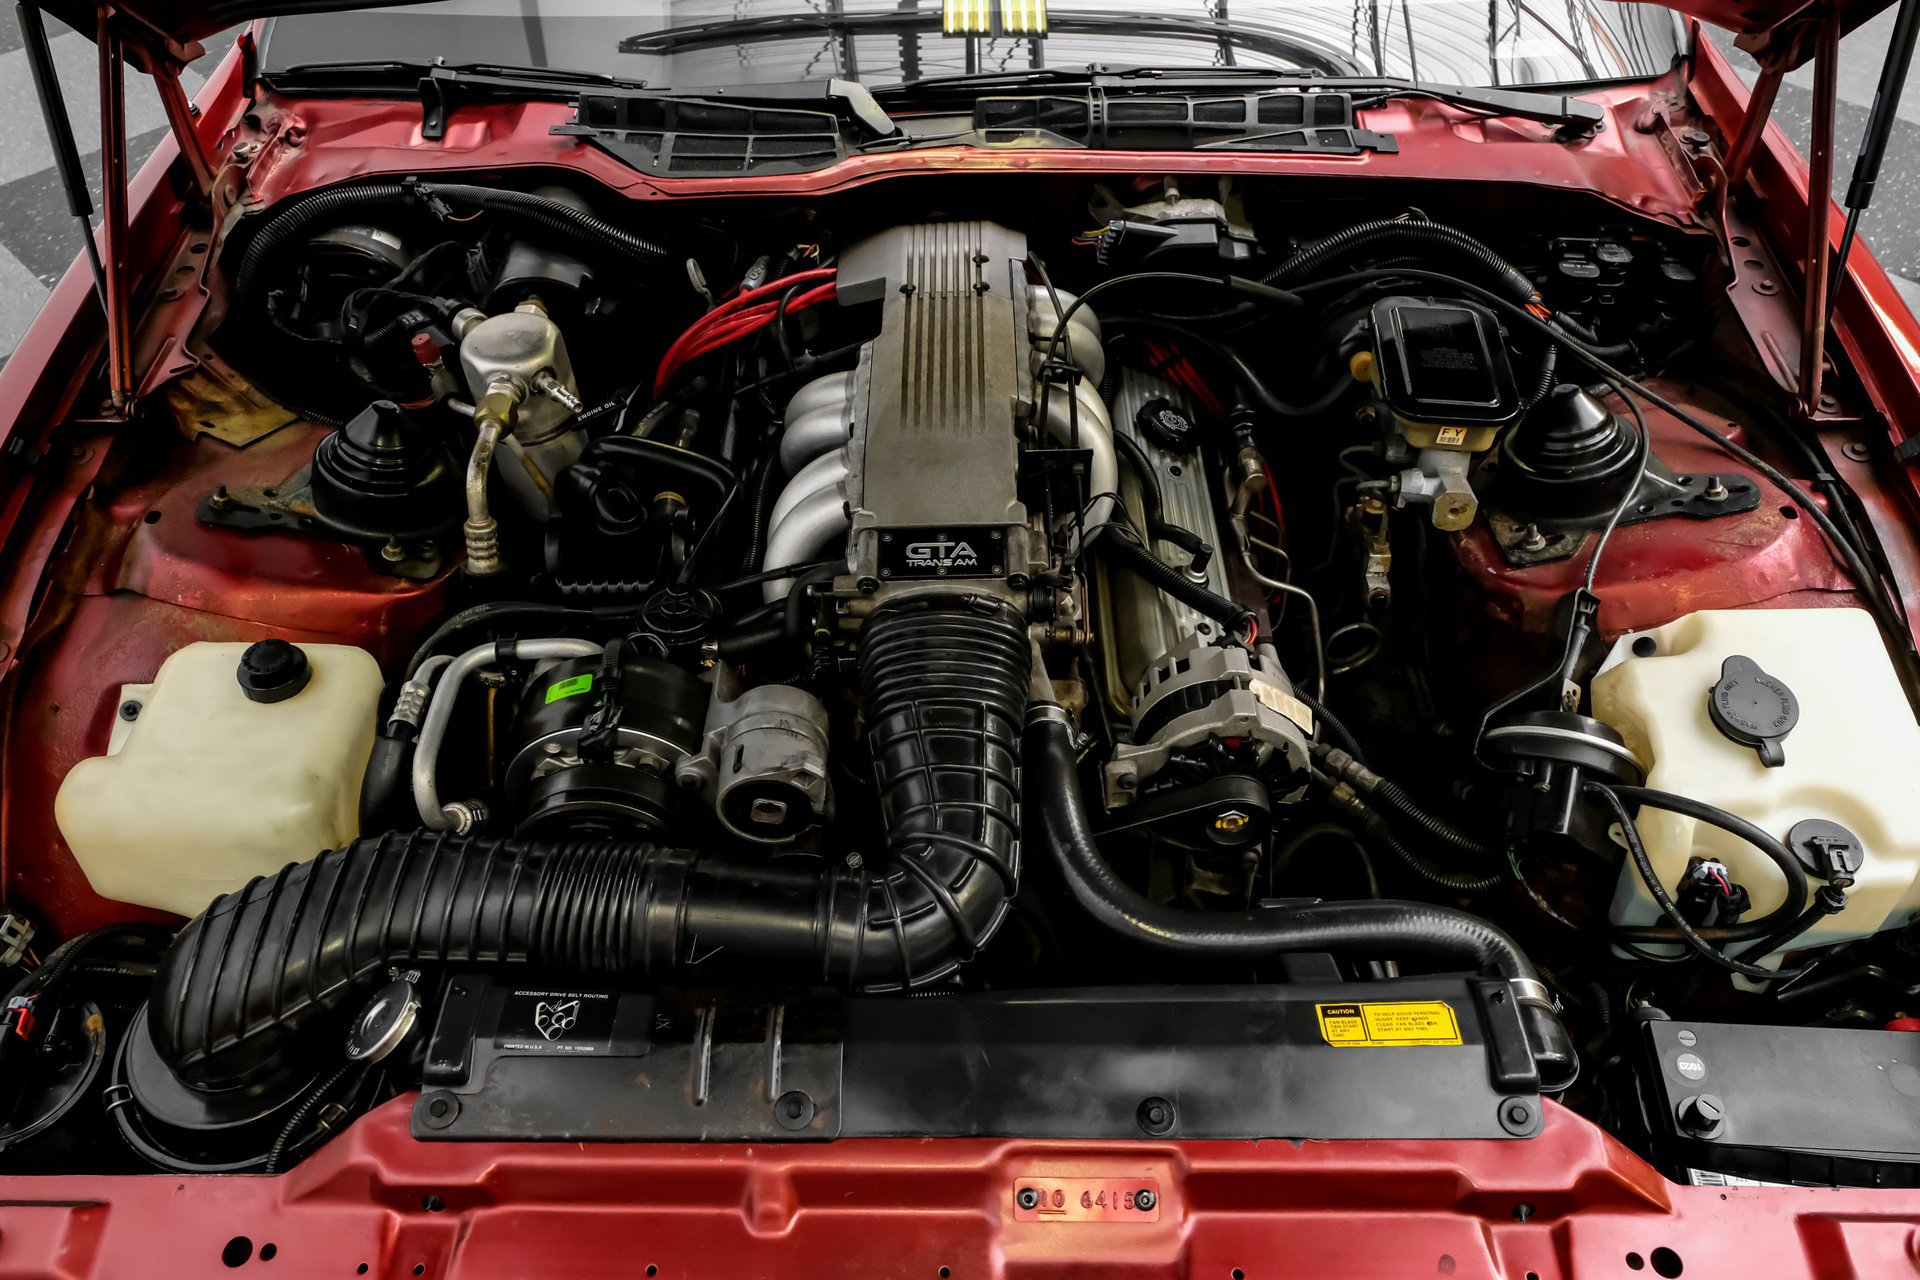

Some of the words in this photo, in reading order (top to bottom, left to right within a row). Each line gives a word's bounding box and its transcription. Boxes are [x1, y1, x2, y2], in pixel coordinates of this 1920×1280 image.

[577, 406, 603, 422] ENGINE
[604, 401, 616, 409] OIL
[1442, 428, 1451, 436] F
[1455, 429, 1463, 437] Y
[905, 541, 977, 559] GTA
[905, 558, 953, 567] TRANS
[954, 558, 977, 566] AM
[1080, 1190, 1136, 1210] 6415
